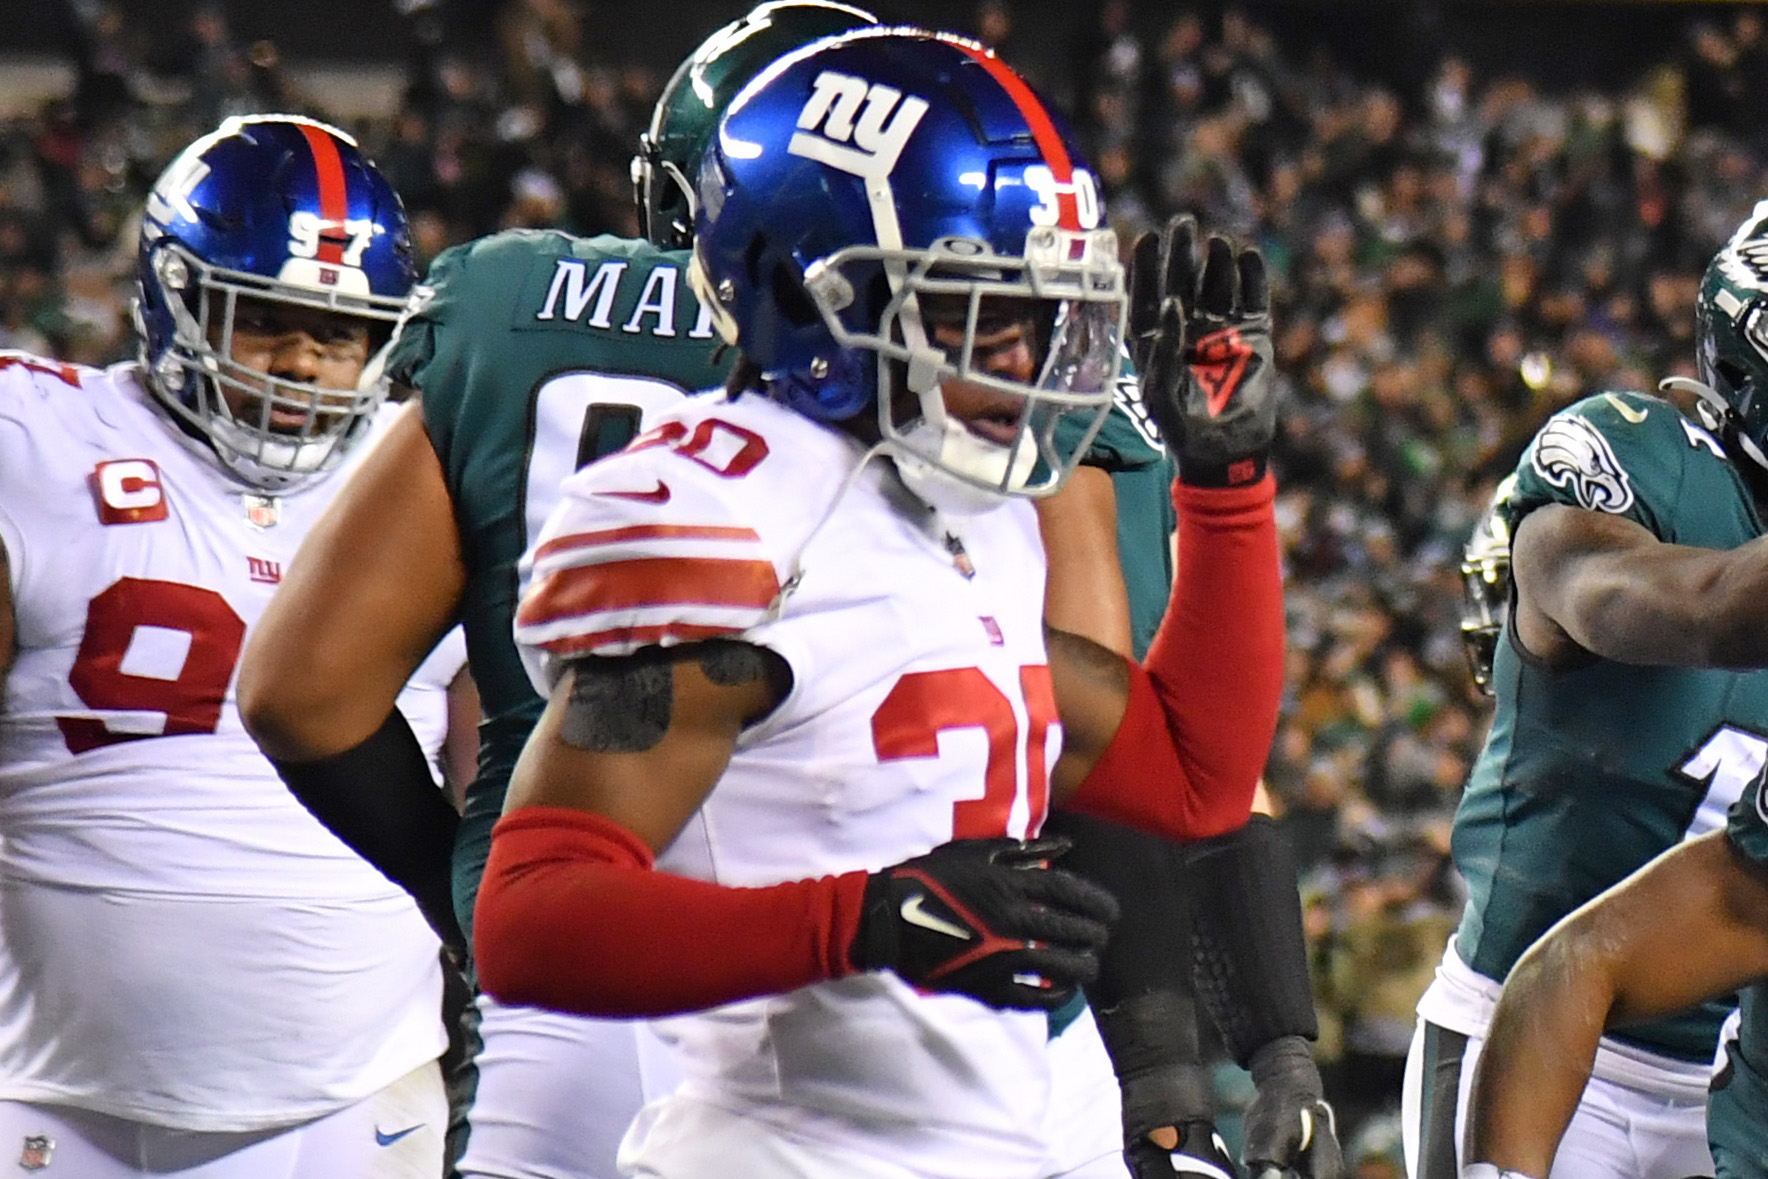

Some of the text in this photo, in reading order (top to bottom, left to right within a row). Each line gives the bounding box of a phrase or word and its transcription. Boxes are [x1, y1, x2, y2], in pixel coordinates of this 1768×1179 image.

[787, 70, 930, 178] ny
[1023, 165, 1099, 230] 30
[288, 211, 386, 267] 97
[101, 459, 161, 510] C
[54, 576, 247, 757] 9
